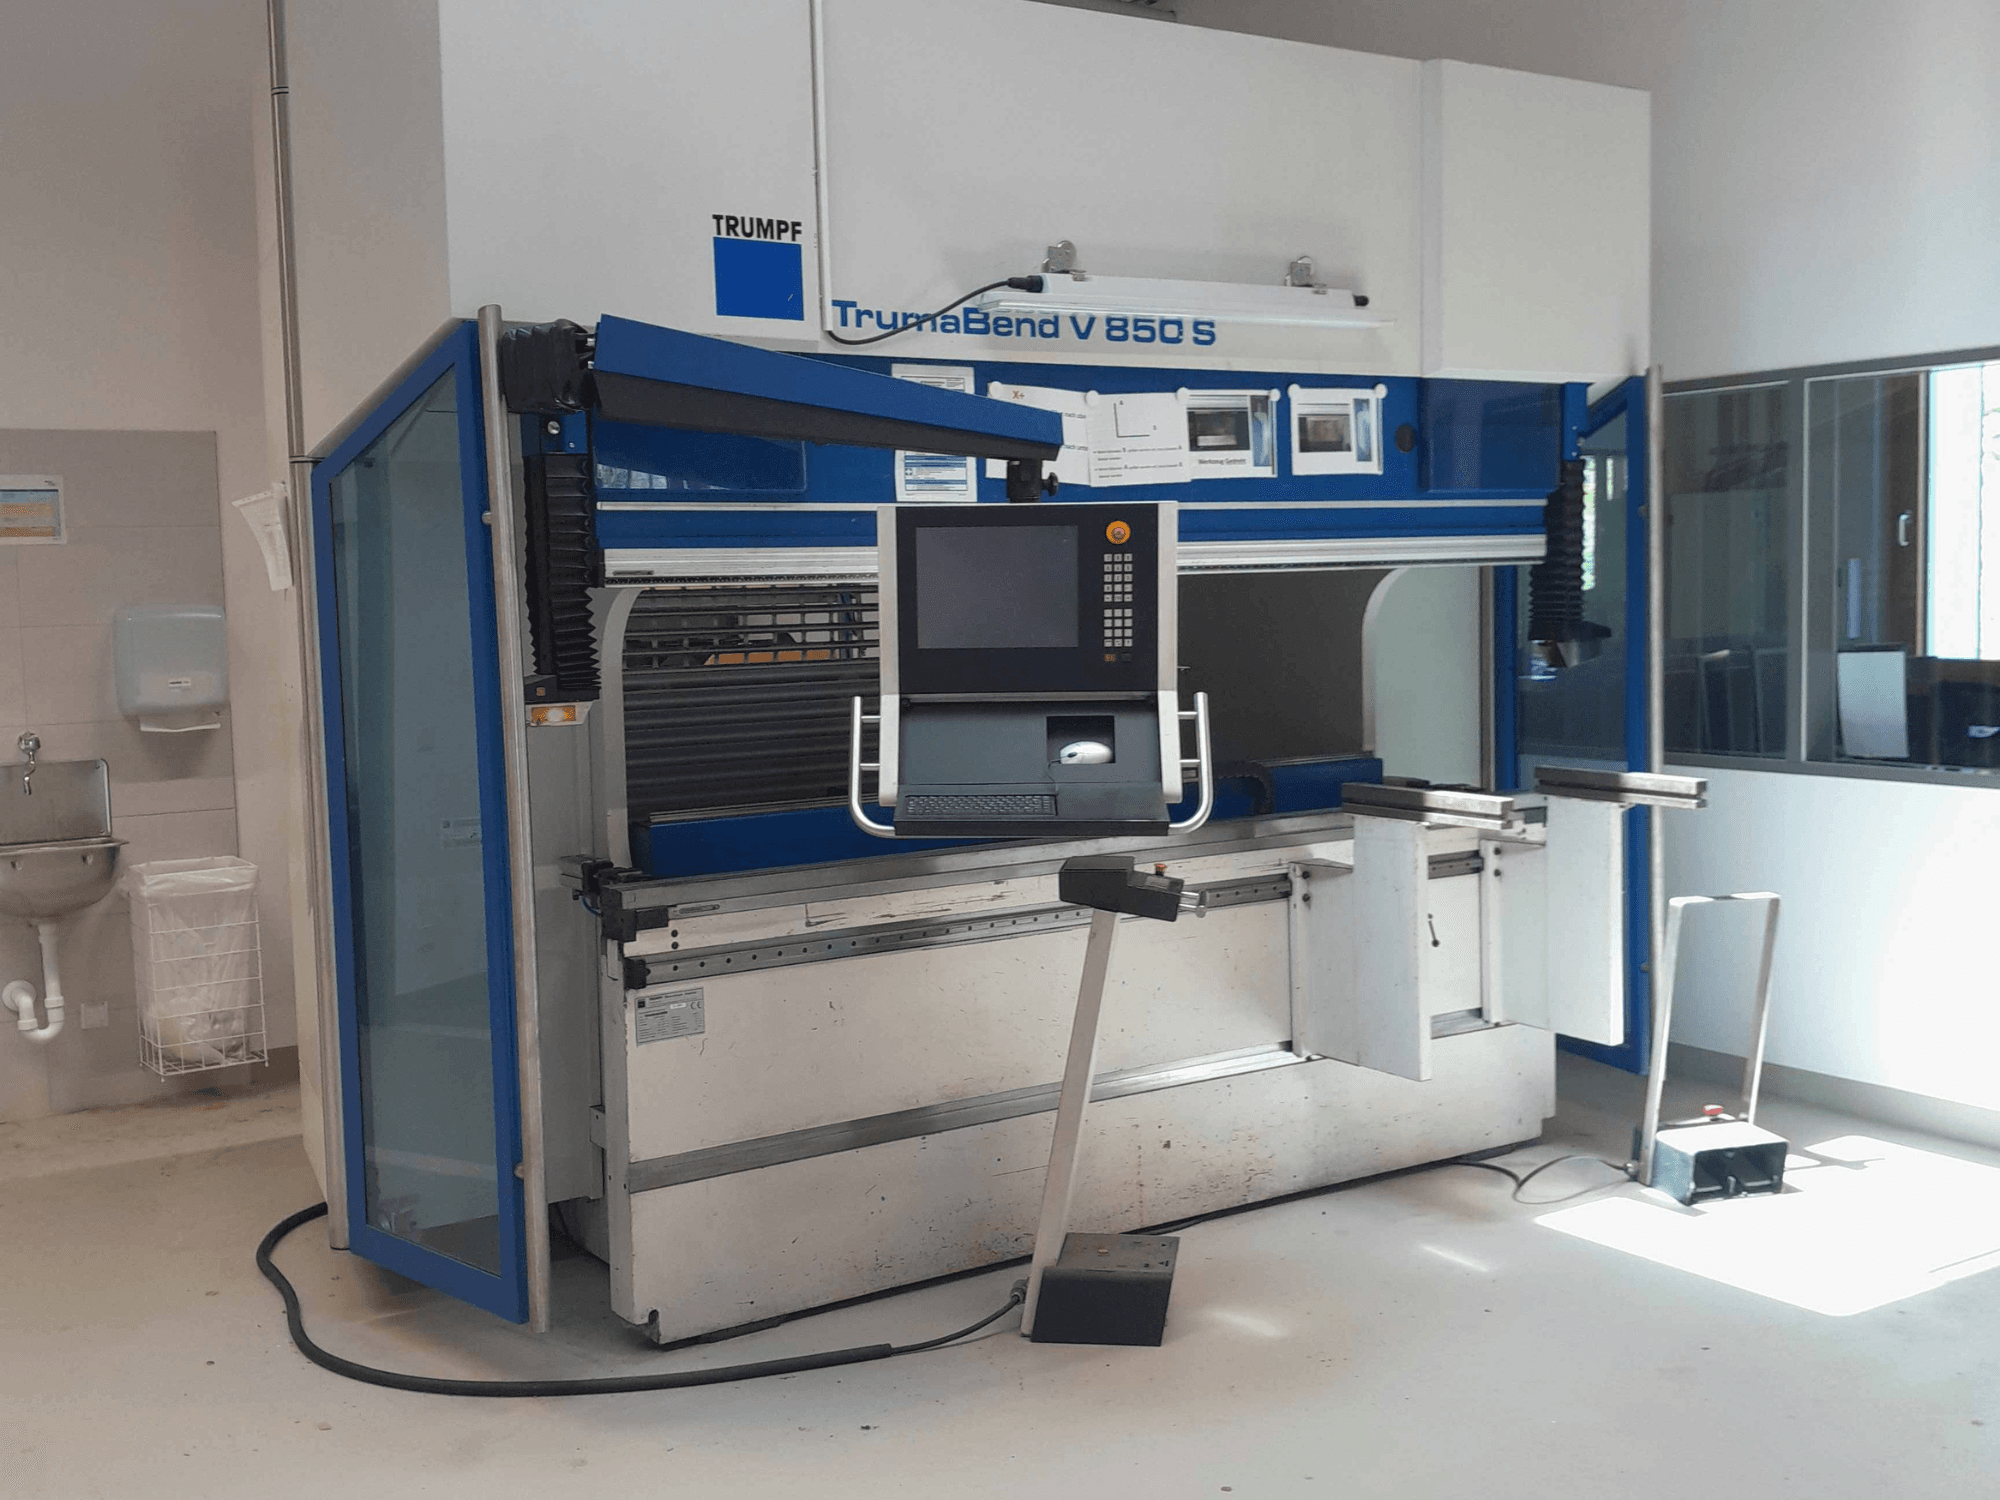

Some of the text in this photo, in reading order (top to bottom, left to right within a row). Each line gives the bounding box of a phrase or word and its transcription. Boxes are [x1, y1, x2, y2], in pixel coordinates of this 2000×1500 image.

[712, 214, 802, 242] TRUMPF
[832, 300, 1216, 346] TrumaBend V 850 S
